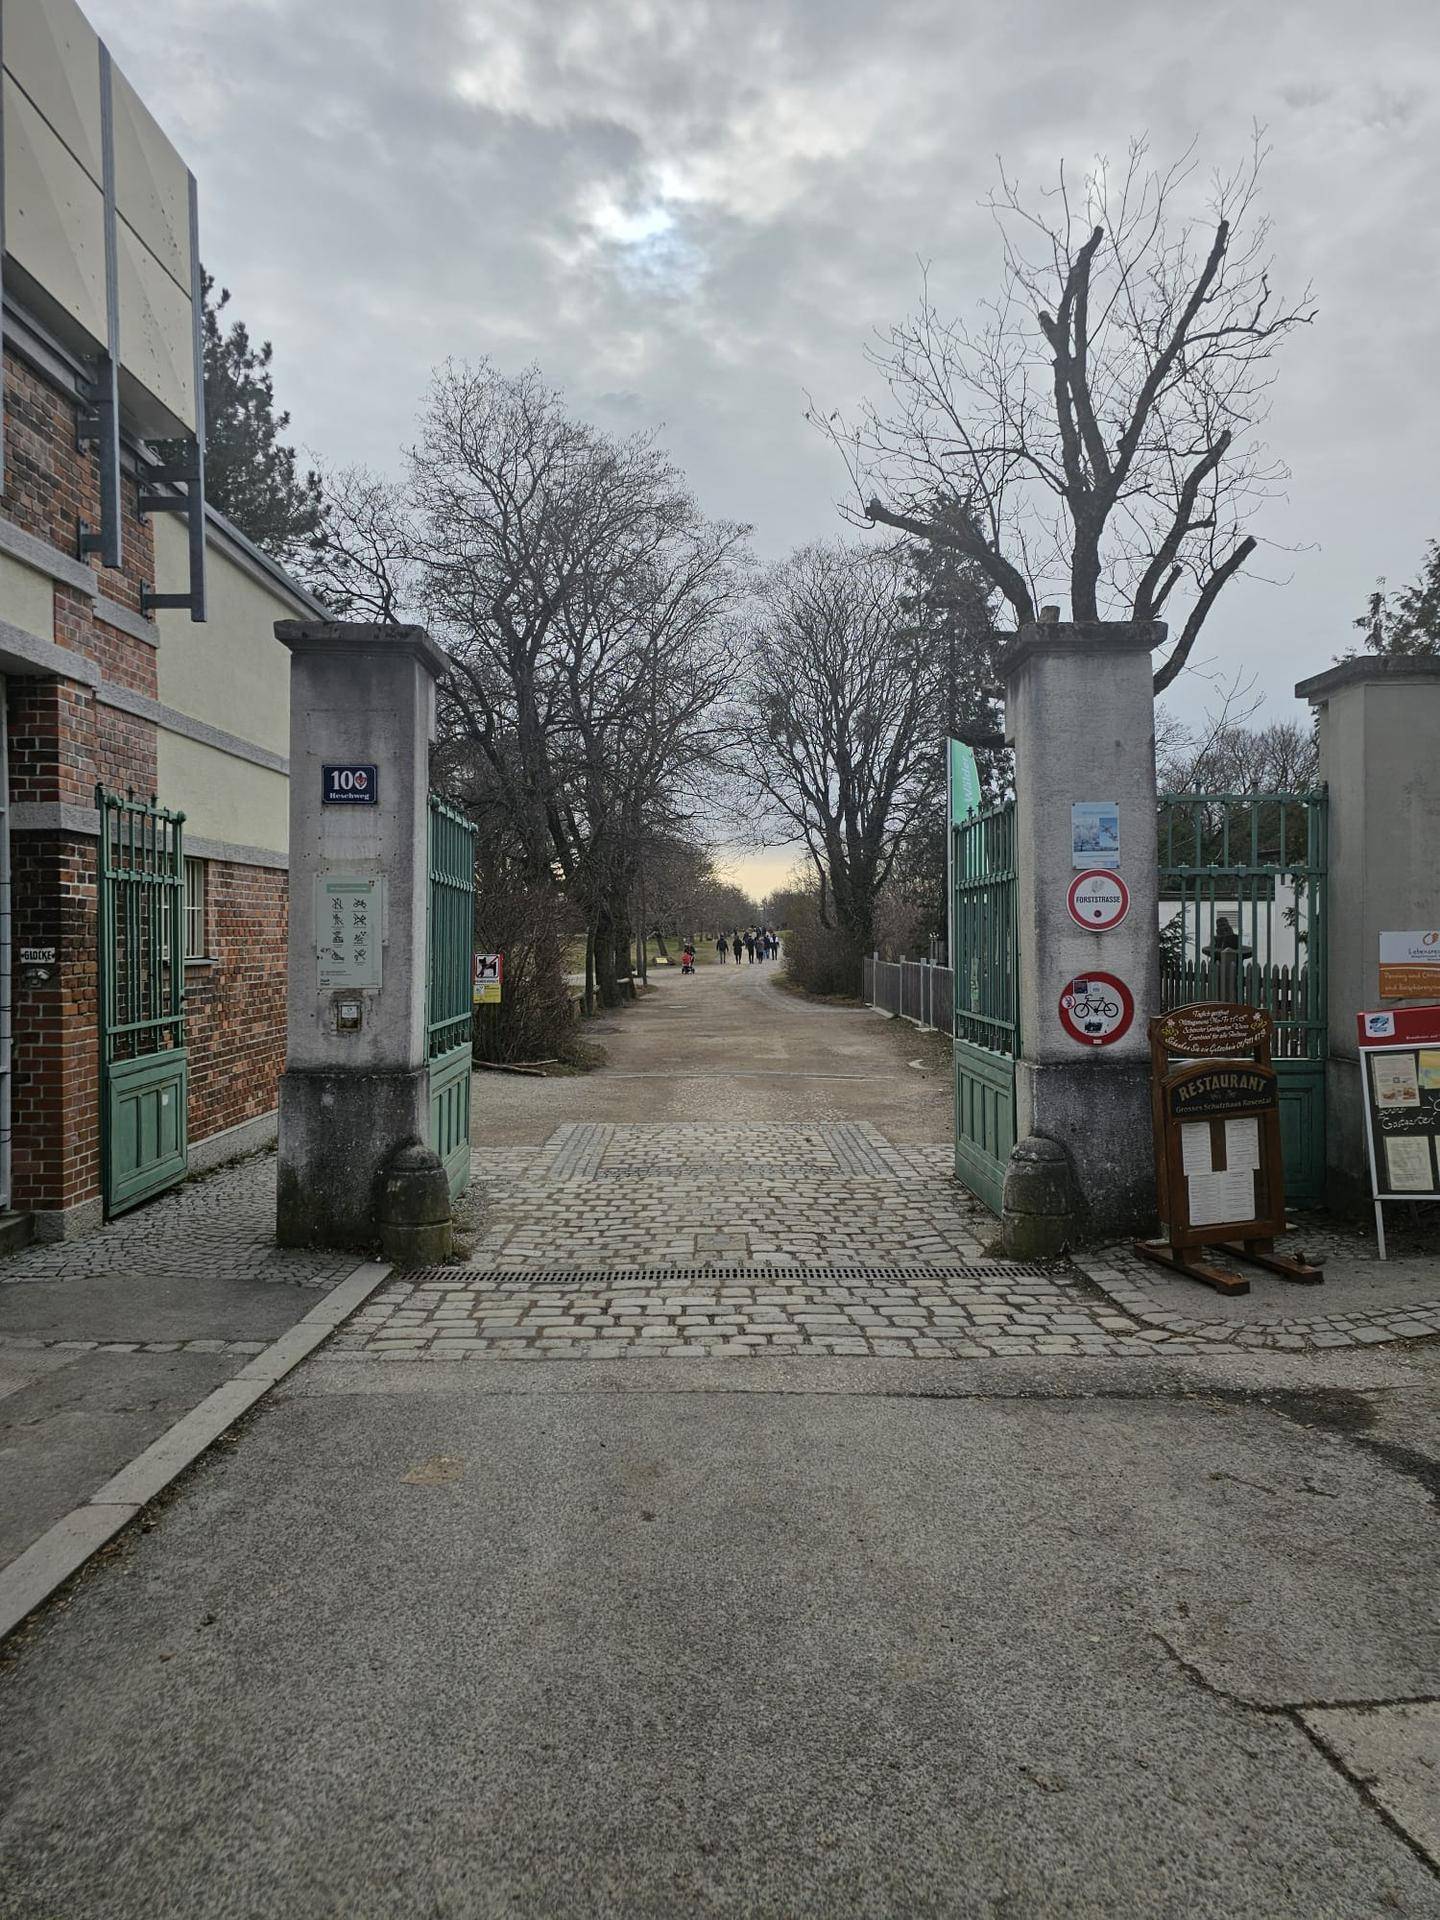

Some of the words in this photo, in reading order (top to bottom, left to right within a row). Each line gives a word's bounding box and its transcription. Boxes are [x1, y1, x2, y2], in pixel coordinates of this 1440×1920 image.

[331, 770, 368, 790] 100
[329, 792, 370, 800] Heschweg
[1076, 896, 1121, 904] FORSTSTRASSE
[24, 950, 52, 960] GLOCKE
[1179, 1074, 1267, 1101] RESTAURANT
